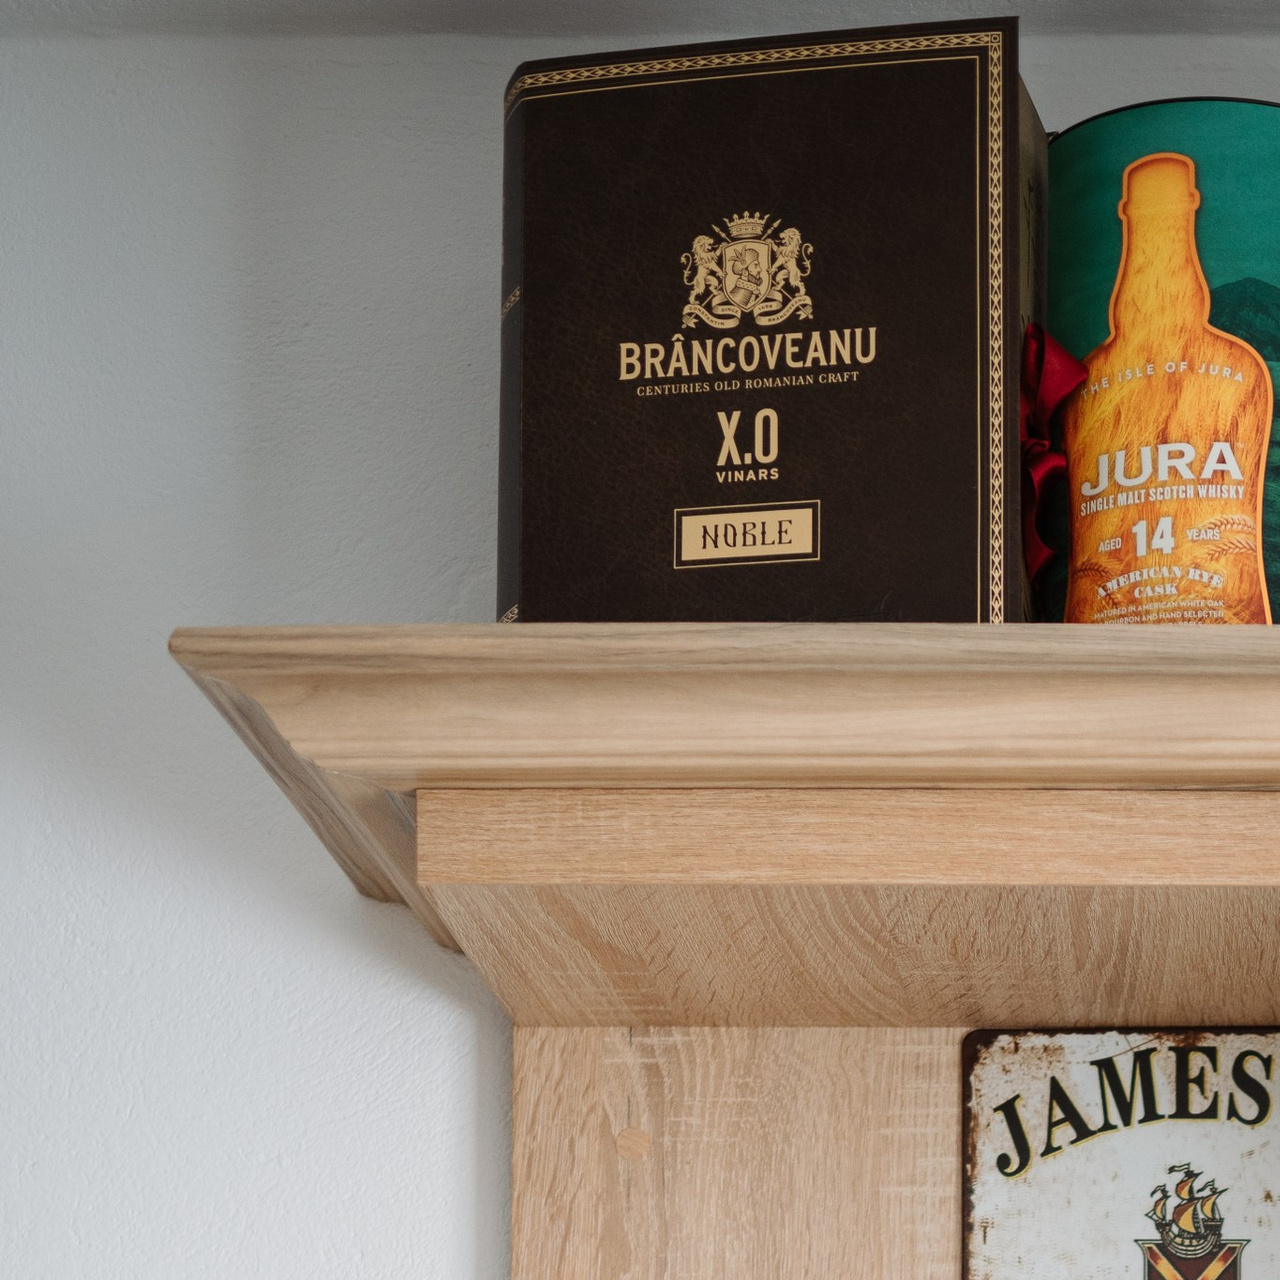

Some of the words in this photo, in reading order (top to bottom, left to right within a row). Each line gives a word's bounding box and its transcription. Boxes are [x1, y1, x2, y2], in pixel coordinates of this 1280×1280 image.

[619, 327, 877, 380] BRÂNCOVEANU
[637, 383, 710, 396] CENTURIES
[714, 381, 740, 391] OLD
[745, 374, 814, 389] ROMANIAN
[819, 371, 859, 383] CRAFT
[1165, 362, 1188, 373] OF
[1198, 364, 1243, 383] JURA
[716, 408, 779, 466] X.O
[716, 468, 779, 483] VINARS
[1081, 441, 1243, 496] JURA
[1080, 498, 1114, 517] SINGLE
[1118, 491, 1146, 506] MALT
[1150, 486, 1194, 501] SCOTCH
[1198, 485, 1244, 499] WHISKY
[702, 520, 793, 549] NOBLE
[1098, 538, 1122, 552] AGED
[1132, 516, 1174, 557] 14
[1187, 529, 1220, 540] YEARS
[1134, 583, 1178, 598] CASK
